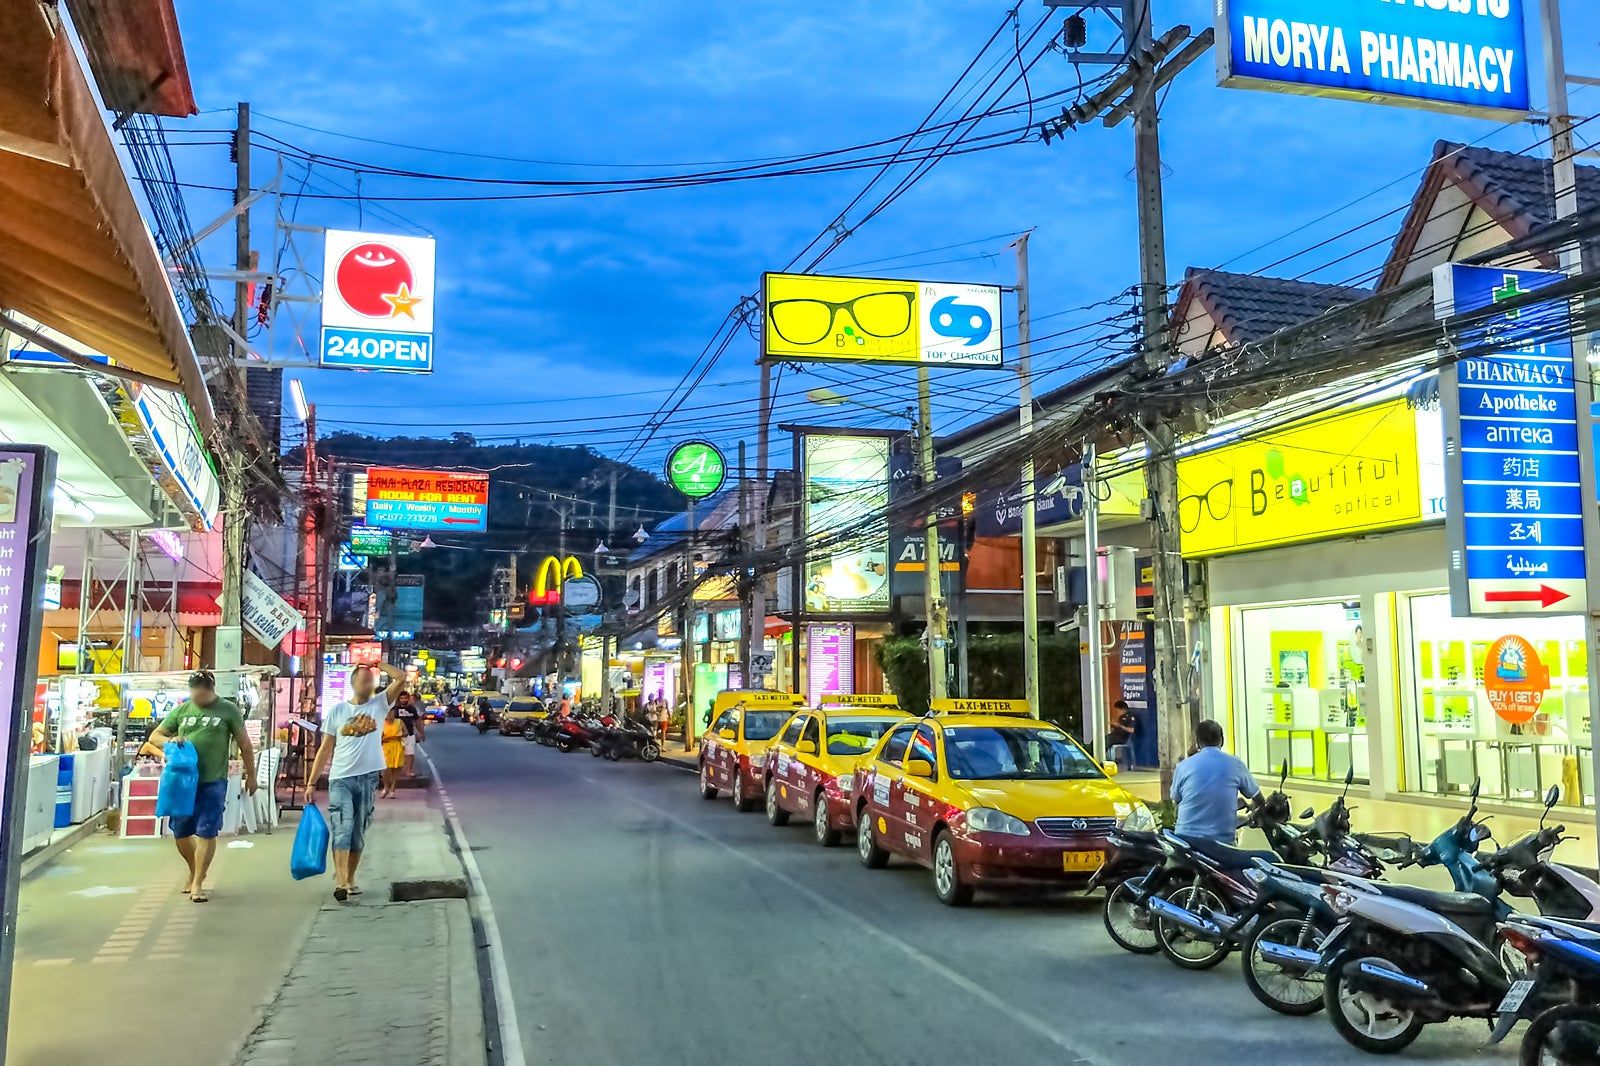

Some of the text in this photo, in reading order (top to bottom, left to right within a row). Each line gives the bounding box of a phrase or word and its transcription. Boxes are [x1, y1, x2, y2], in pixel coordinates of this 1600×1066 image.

[1243, 16, 1514, 94] MORYA PHARMACY
[926, 351, 947, 359] TOP
[1466, 360, 1565, 385] PHARMACY
[1479, 392, 1557, 414] Apotheke
[1486, 426, 1553, 444] аптека
[1503, 457, 1539, 478] 药店
[435, 480, 486, 493] RESIDENCE
[1251, 453, 1400, 517] Beautiful
[379, 490, 477, 504] ROOM FOR RENT
[1036, 496, 1055, 511] Bank
[1334, 490, 1401, 514] optical
[1505, 488, 1541, 511] 薬局
[372, 501, 393, 511] Daily
[406, 503, 436, 513] Weekly
[448, 505, 482, 515] Monthly
[1509, 520, 1542, 544] 조제
[1506, 554, 1549, 576] صيدلية
[253, 613, 285, 640] seafood
[1122, 656, 1142, 664] Deposit
[837, 695, 883, 704] TAXI-METER
[1488, 690, 1541, 703] BUY 1 GET 3
[953, 701, 1012, 711] TAXI-METER
[1493, 701, 1507, 711] 50%
[1507, 703, 1517, 711] off
